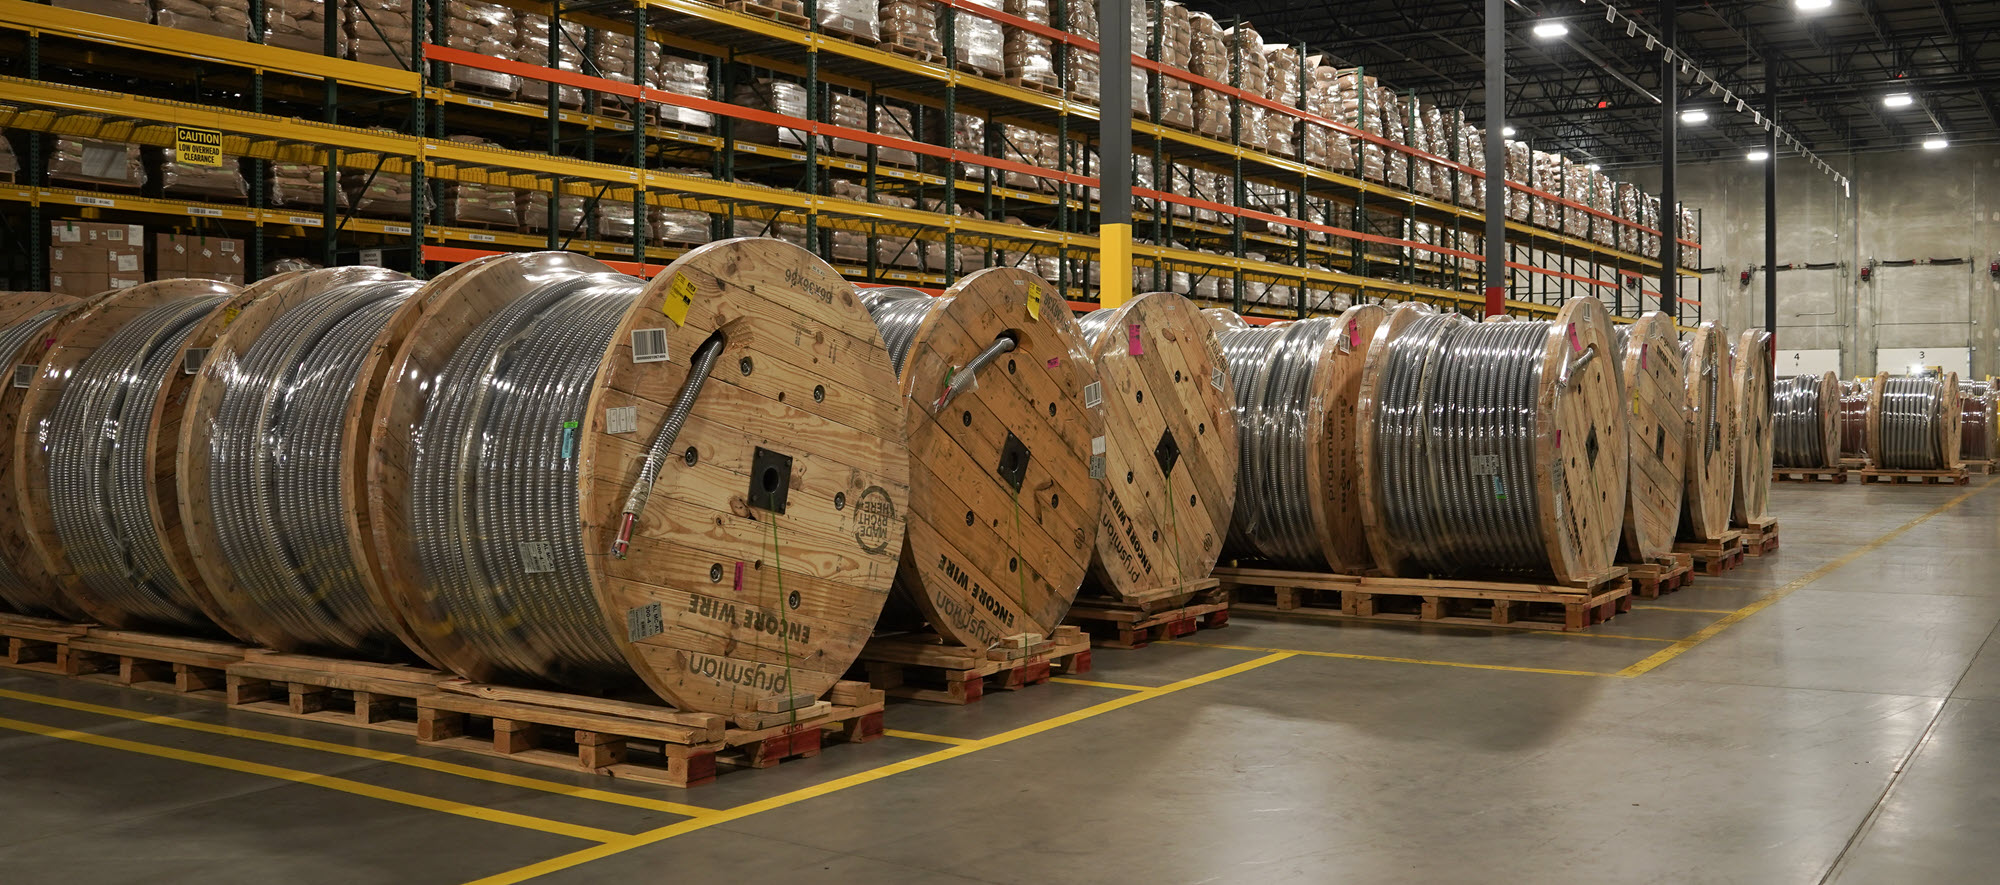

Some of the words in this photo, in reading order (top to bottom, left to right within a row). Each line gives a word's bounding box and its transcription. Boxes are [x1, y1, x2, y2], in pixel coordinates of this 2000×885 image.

[178, 143, 191, 153] LOW
[191, 145, 220, 156] OVERHEAD
[179, 130, 220, 144] CAUTION
[183, 152, 215, 164] CLEARANCE
[1919, 351, 1925, 359] 3
[1326, 409, 1335, 501] prysmian
[1107, 488, 1126, 527] WIRE
[860, 526, 888, 539] MADE
[1100, 513, 1141, 584] prysmian
[1125, 524, 1151, 575] ENCORE
[938, 553, 969, 591] WIRE
[688, 594, 736, 624] WIRE
[971, 582, 1015, 629] ENCORE
[743, 609, 810, 644] ENCORE
[689, 653, 789, 694] prysmian
